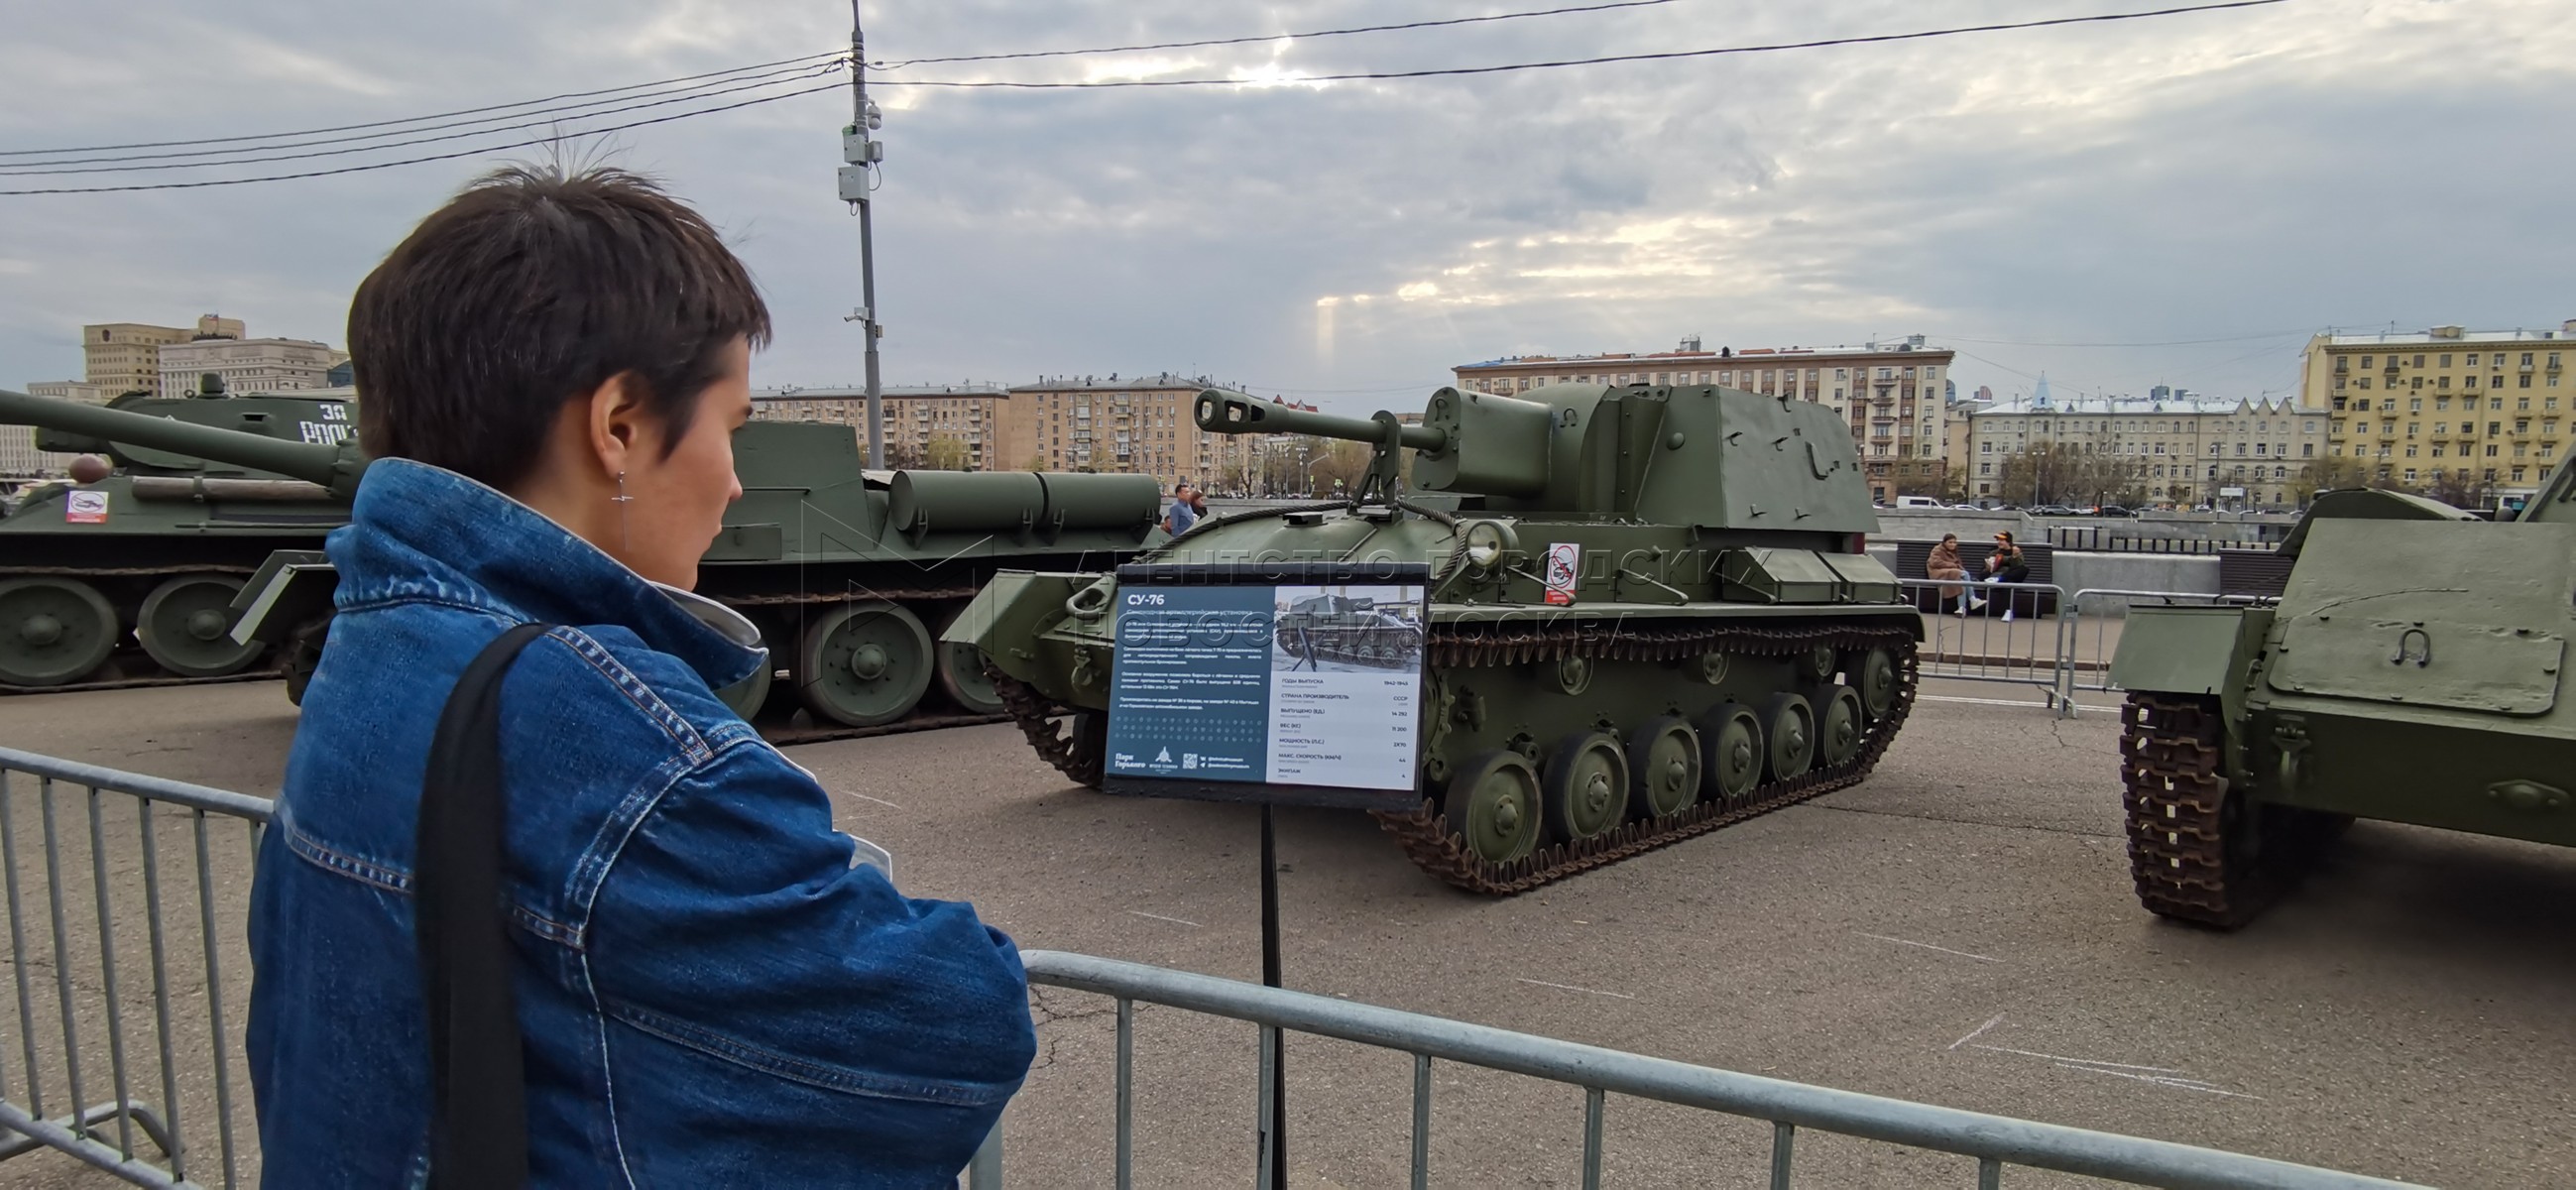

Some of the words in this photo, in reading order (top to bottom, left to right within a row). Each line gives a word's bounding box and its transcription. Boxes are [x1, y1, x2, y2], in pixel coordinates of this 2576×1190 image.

[319, 404, 348, 420] ЗА
[1127, 594, 1165, 606] СУ-76
[1115, 753, 1134, 762] Парк
